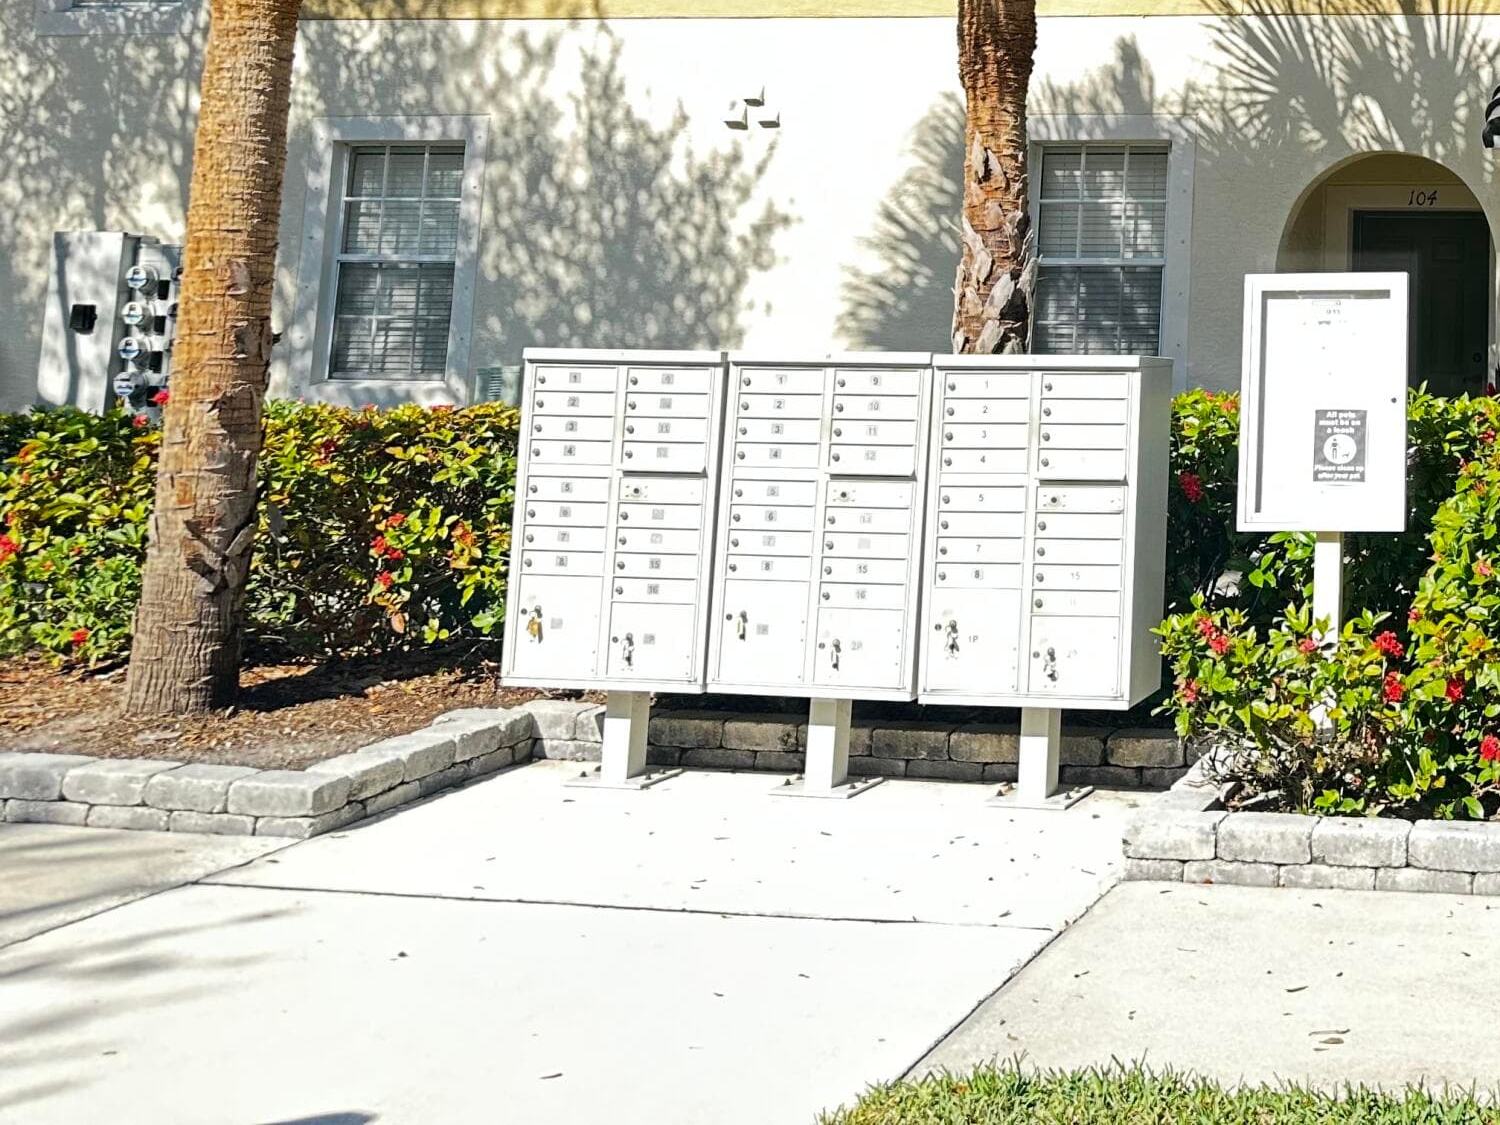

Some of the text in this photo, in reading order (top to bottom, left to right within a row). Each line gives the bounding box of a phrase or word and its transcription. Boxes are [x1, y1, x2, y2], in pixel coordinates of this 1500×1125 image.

[1408, 189, 1438, 206] 104
[870, 402, 879, 411] 10
[1338, 411, 1356, 419] pets
[869, 427, 877, 436] 11
[858, 565, 868, 574] 15
[1070, 571, 1080, 580] 15
[857, 590, 866, 599] 16
[968, 635, 978, 643] 1P
